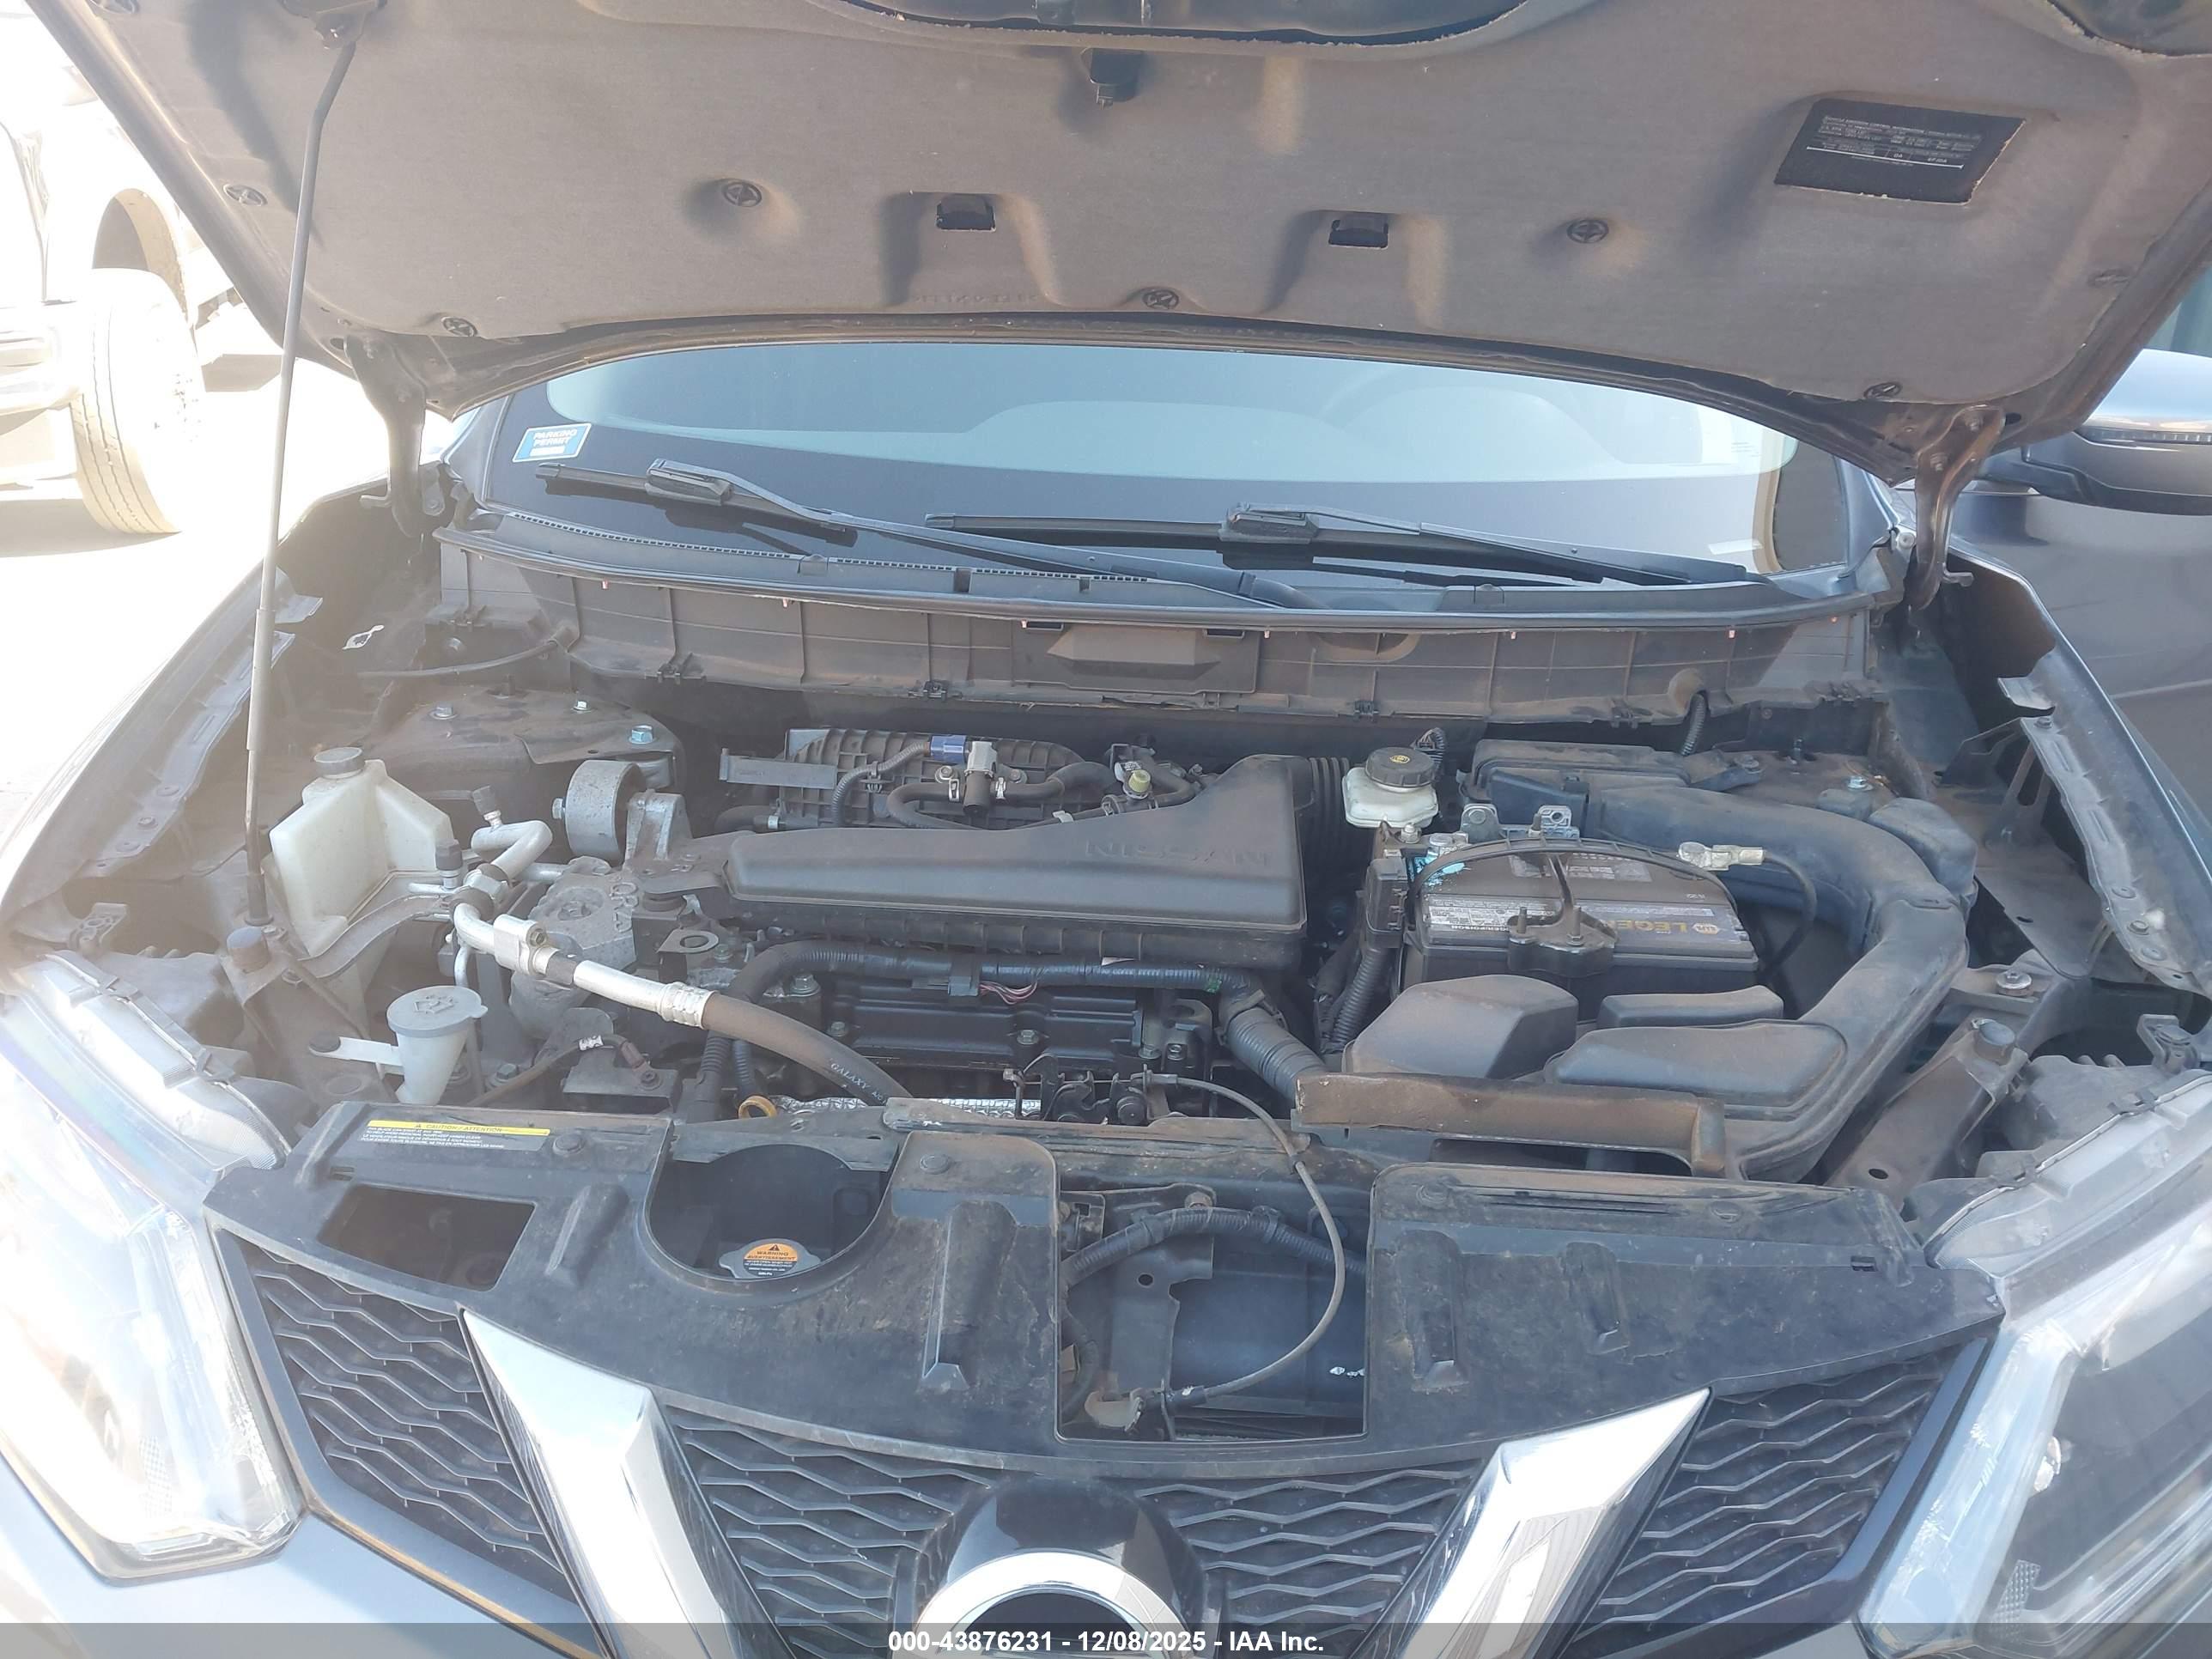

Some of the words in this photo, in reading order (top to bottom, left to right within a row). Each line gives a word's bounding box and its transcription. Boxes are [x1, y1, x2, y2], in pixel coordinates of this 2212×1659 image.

[532, 428, 578, 440] PARKING
[533, 437, 571, 447] PERMIT
[1085, 839, 1270, 866] NISSAN
[830, 1062, 872, 1090] GALAXY
